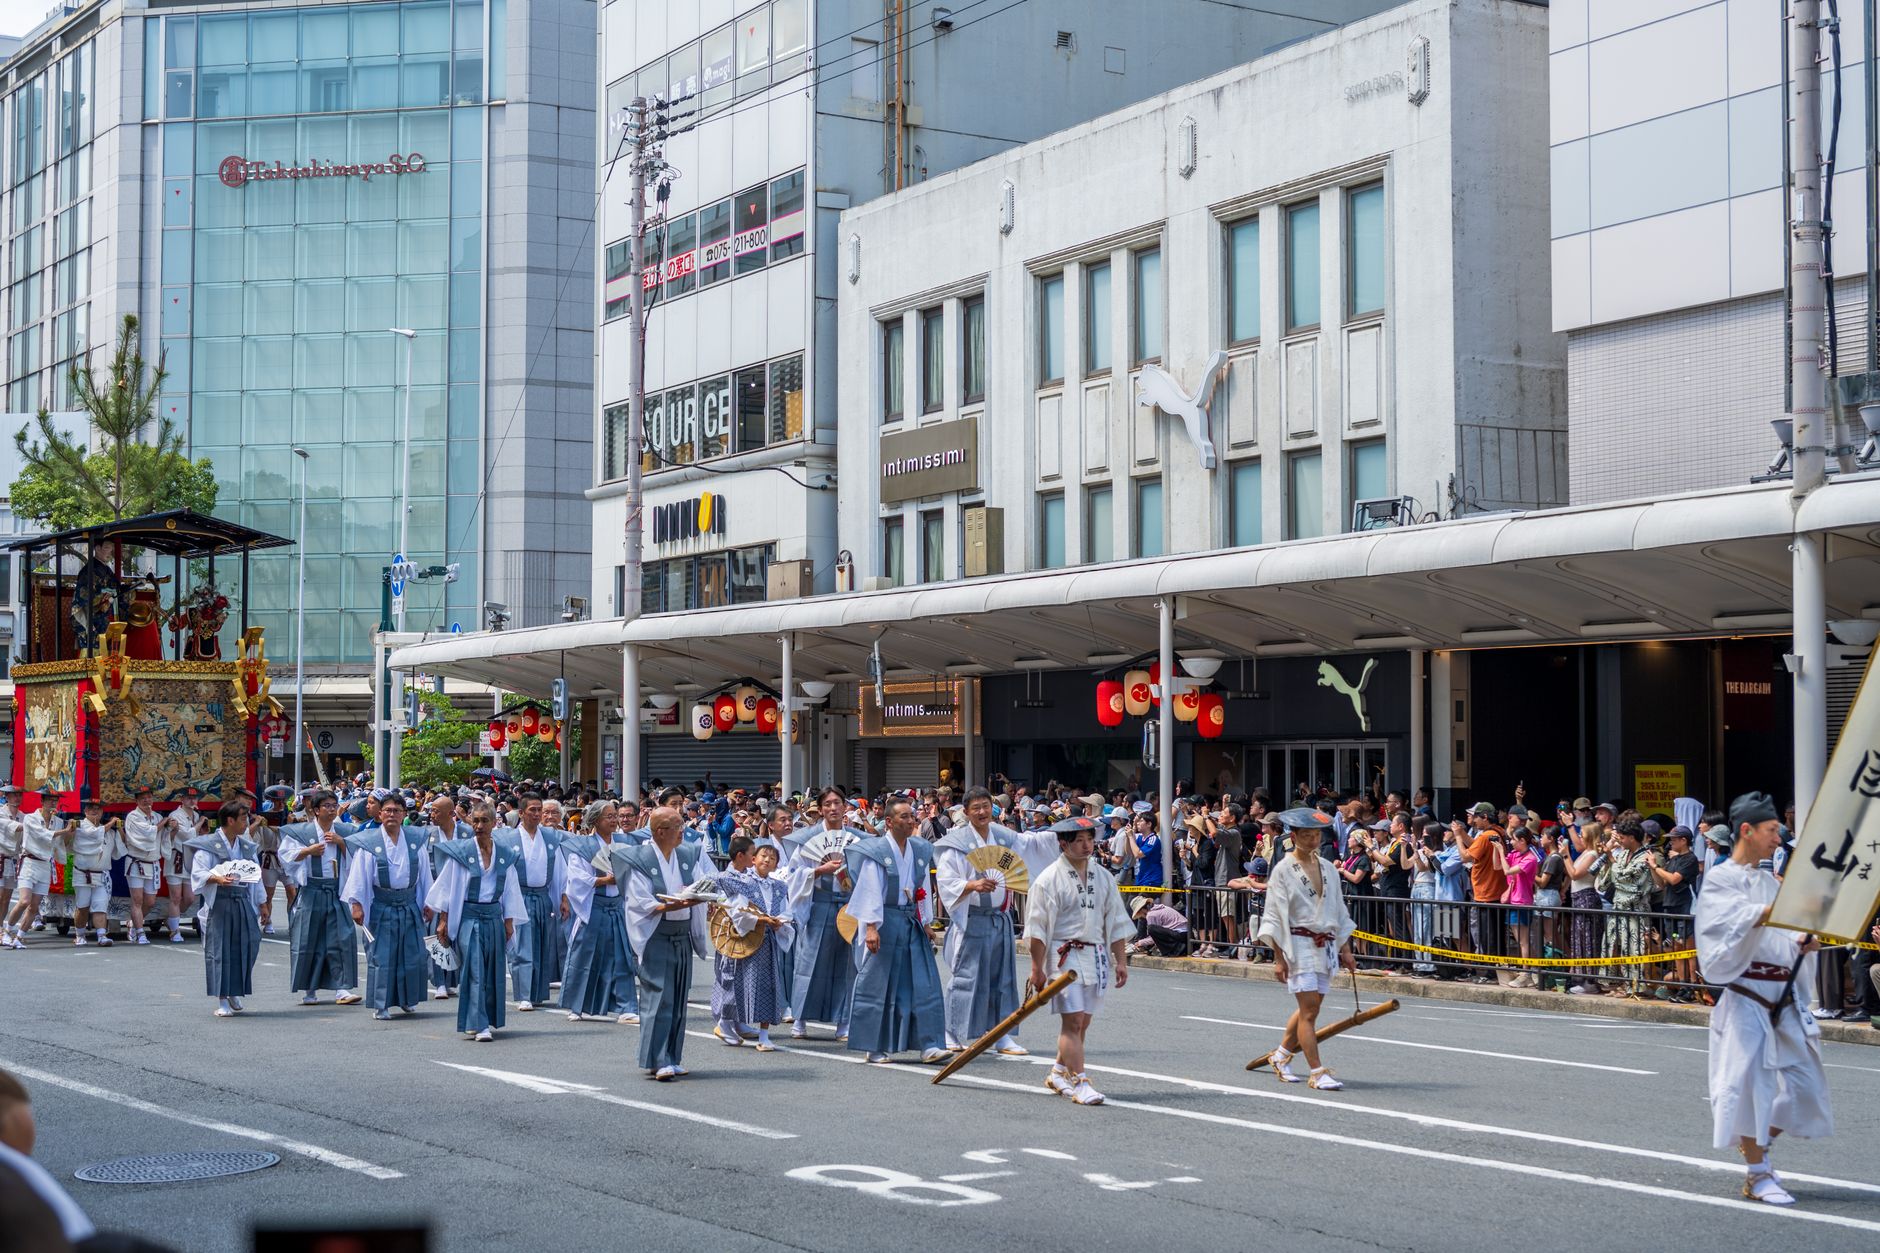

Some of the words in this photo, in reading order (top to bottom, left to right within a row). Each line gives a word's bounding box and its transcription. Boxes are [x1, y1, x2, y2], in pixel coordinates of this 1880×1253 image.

[250, 159, 385, 182] Takashimaya
[883, 448, 964, 476] intimissimi
[1726, 682, 1740, 694] THE
[1740, 682, 1771, 694] BARGAIN
